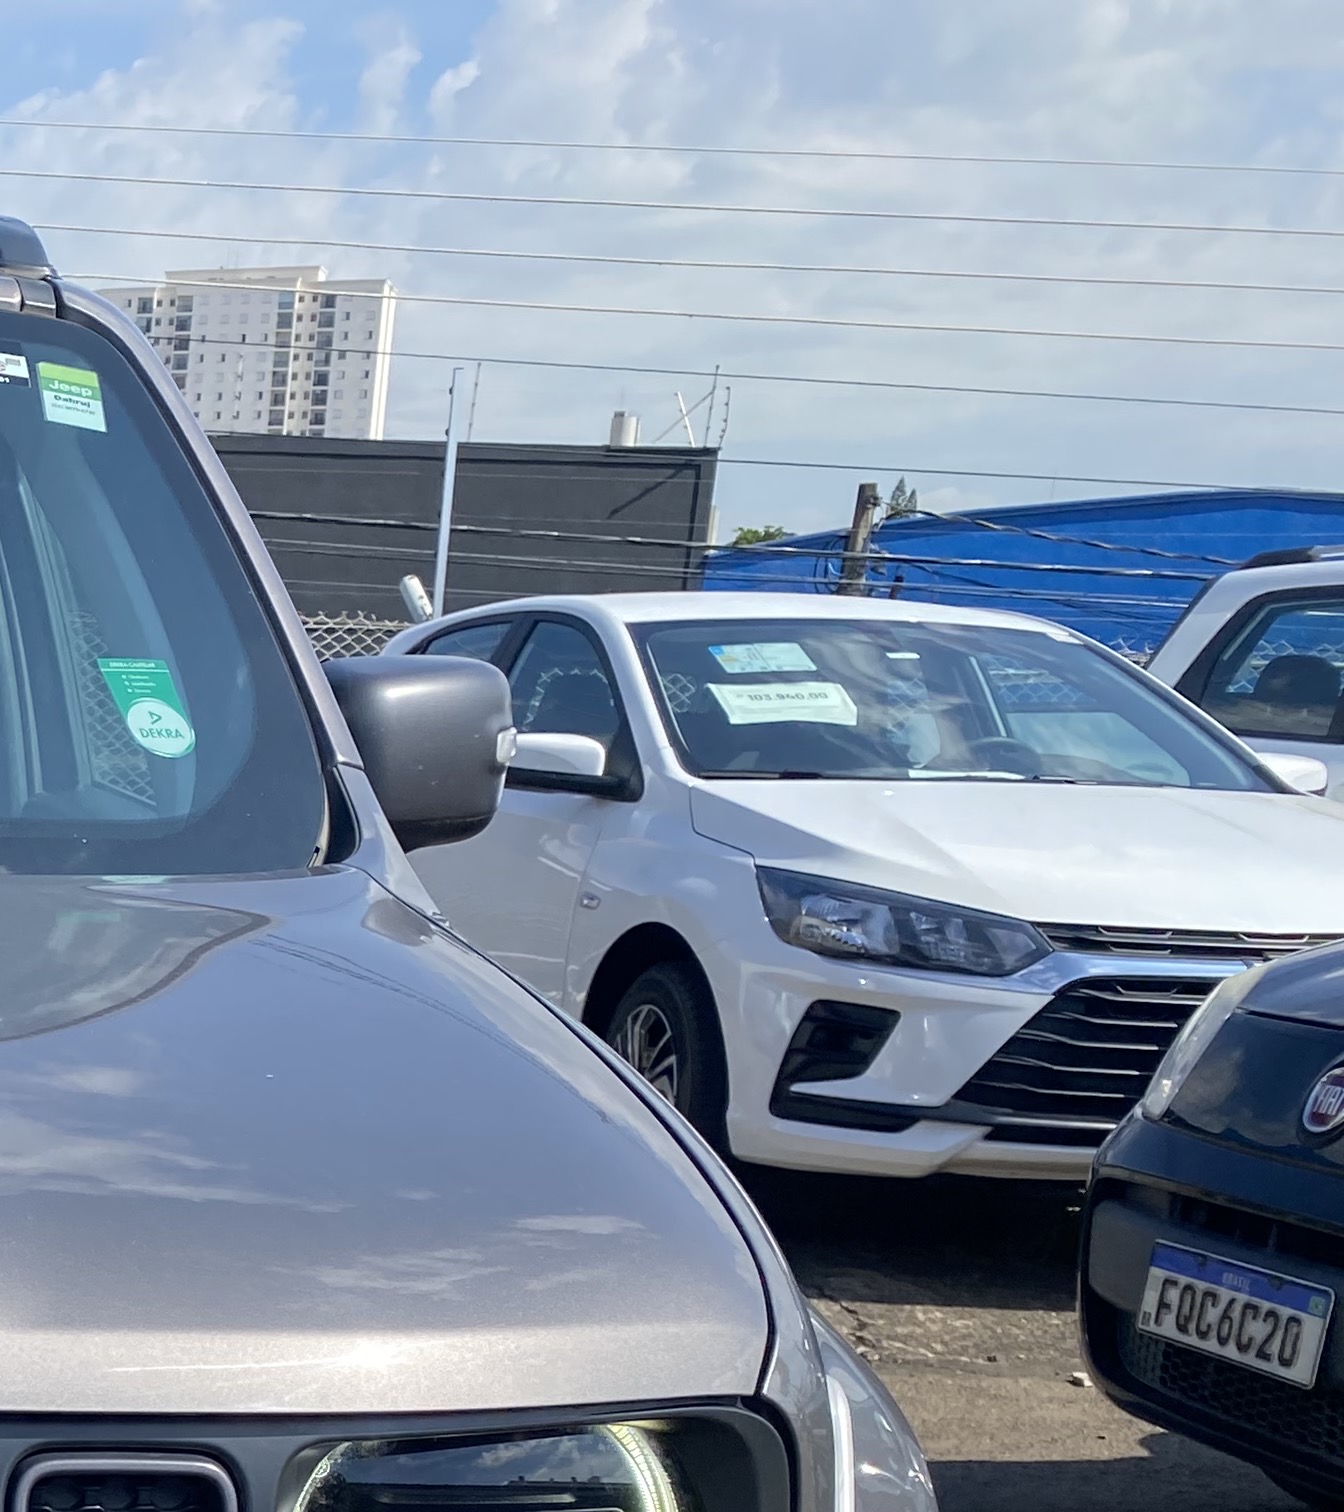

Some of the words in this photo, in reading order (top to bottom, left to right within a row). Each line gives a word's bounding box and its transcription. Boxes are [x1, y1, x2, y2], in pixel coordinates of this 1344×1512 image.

[48, 380, 93, 397] Jeep
[138, 727, 185, 740] DEKRA
[1153, 1277, 1302, 1368] FQC6C20
